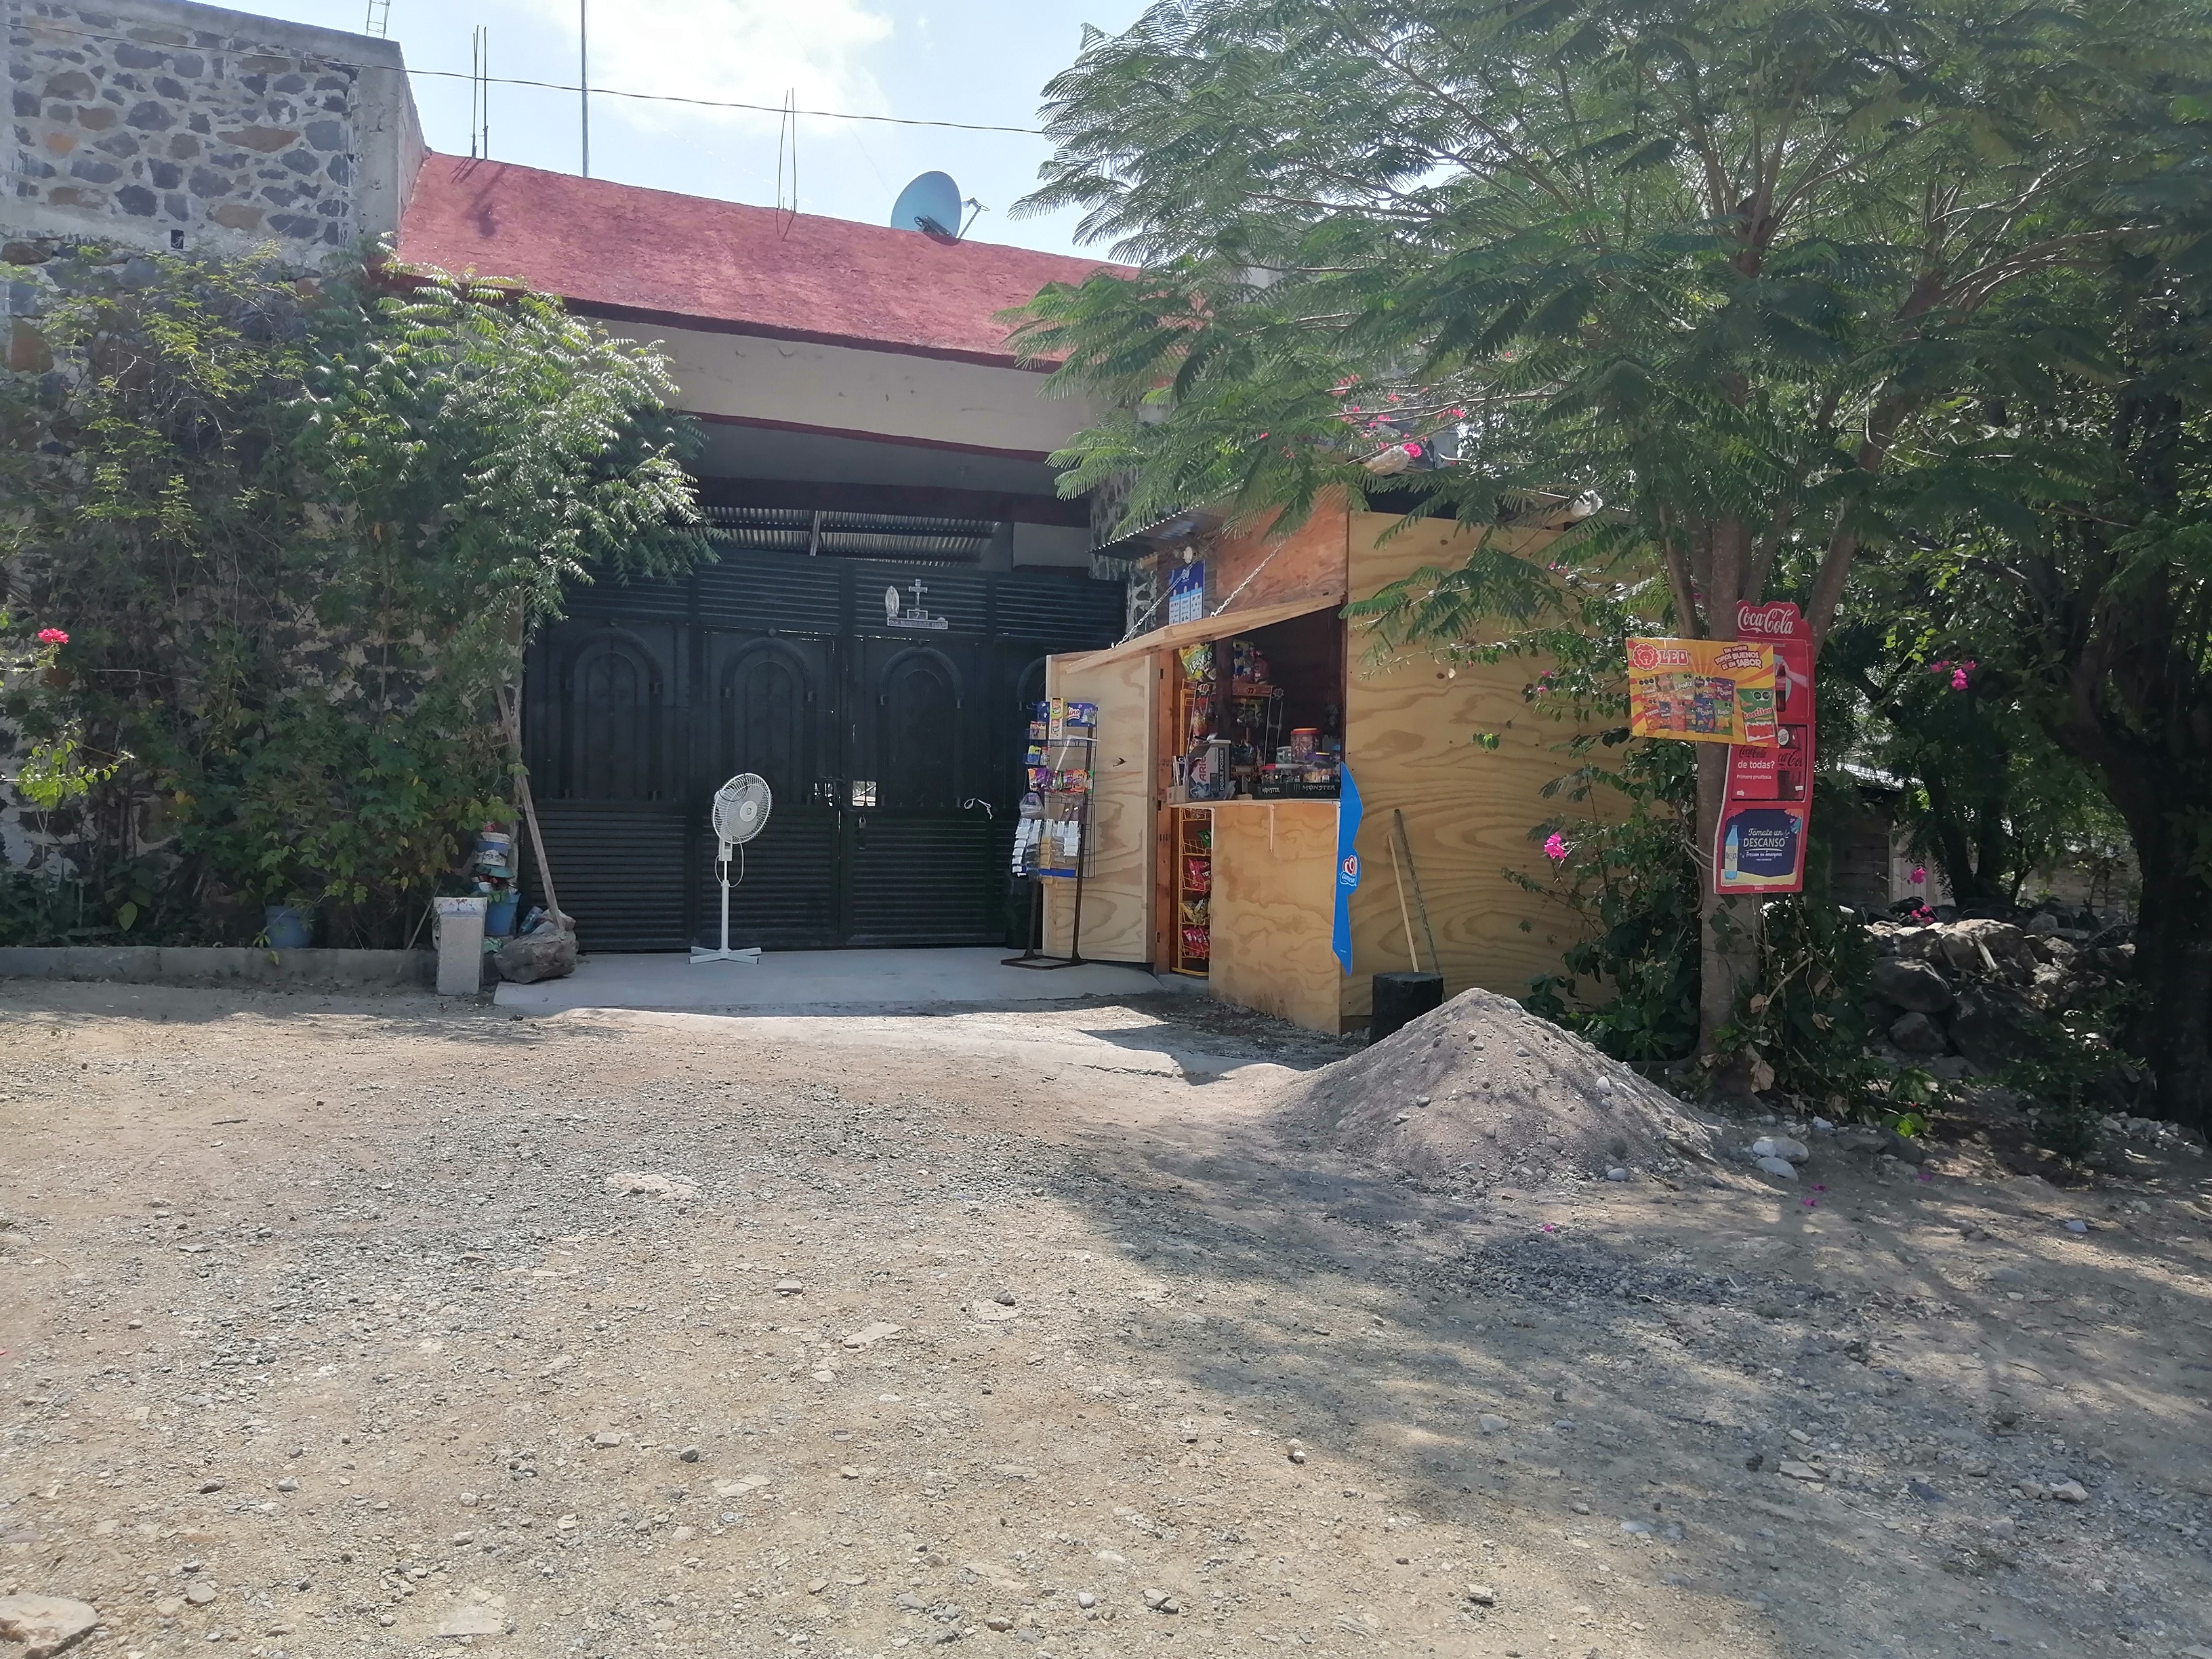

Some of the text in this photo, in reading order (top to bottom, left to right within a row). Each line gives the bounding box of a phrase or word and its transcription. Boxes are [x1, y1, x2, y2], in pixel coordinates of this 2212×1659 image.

[1738, 607, 1795, 634] Coca-Cola
[1660, 649, 1689, 665] LEO
[1715, 651, 1759, 664] SOMOS BUENOS
[1736, 658, 1762, 668] SABOR
[1738, 760, 1775, 769] de todas?
[1748, 828, 1773, 836] Tómate
[1743, 838, 1786, 847] DESCANSO
